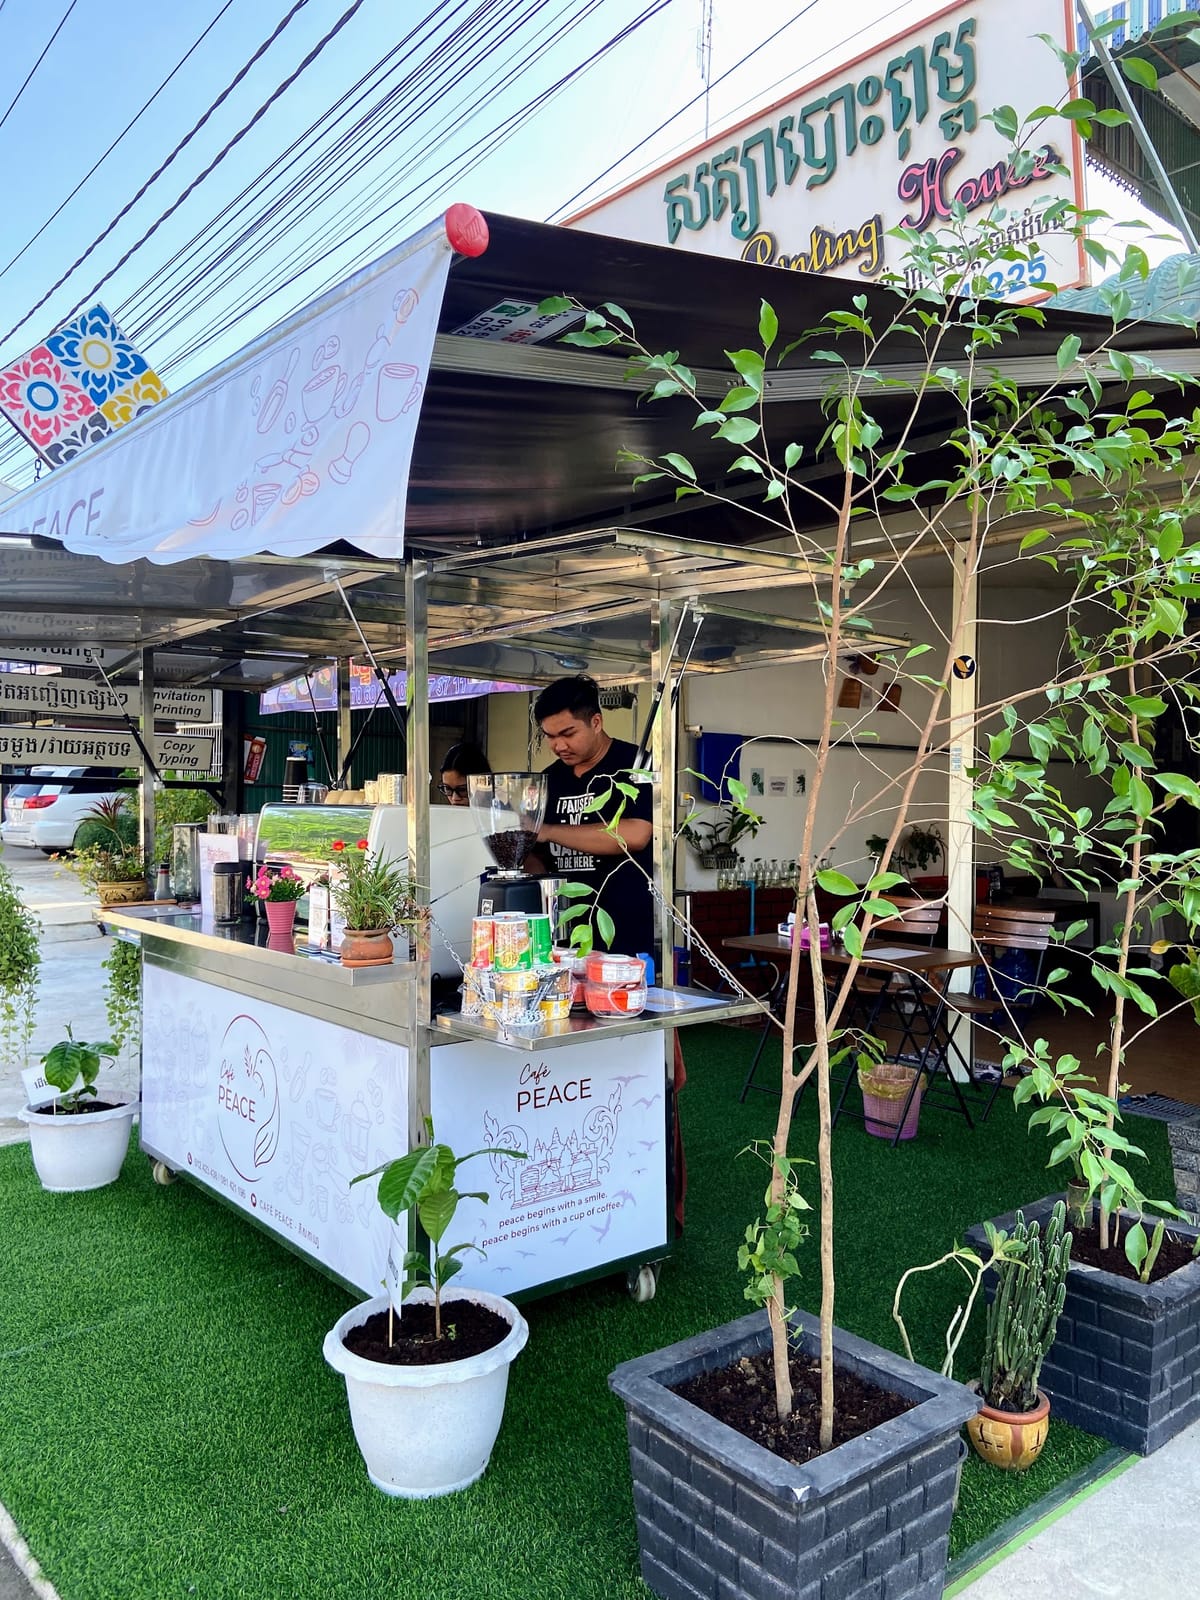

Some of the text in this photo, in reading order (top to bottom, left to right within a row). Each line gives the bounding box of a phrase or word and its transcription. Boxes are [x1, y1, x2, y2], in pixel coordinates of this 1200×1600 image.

[152, 689, 206, 702] nvitation
[153, 703, 202, 717] Printing
[163, 739, 196, 753] Copy
[158, 752, 199, 767] Typing
[557, 855, 594, 869] TO BE HERE
[519, 1061, 551, 1086] Café
[218, 1084, 256, 1123] PEACE
[517, 1078, 592, 1113] PEACE
[499, 1190, 608, 1229] peace begins with a smile.
[482, 1200, 624, 1248] peace begins with a cup of coffee.
